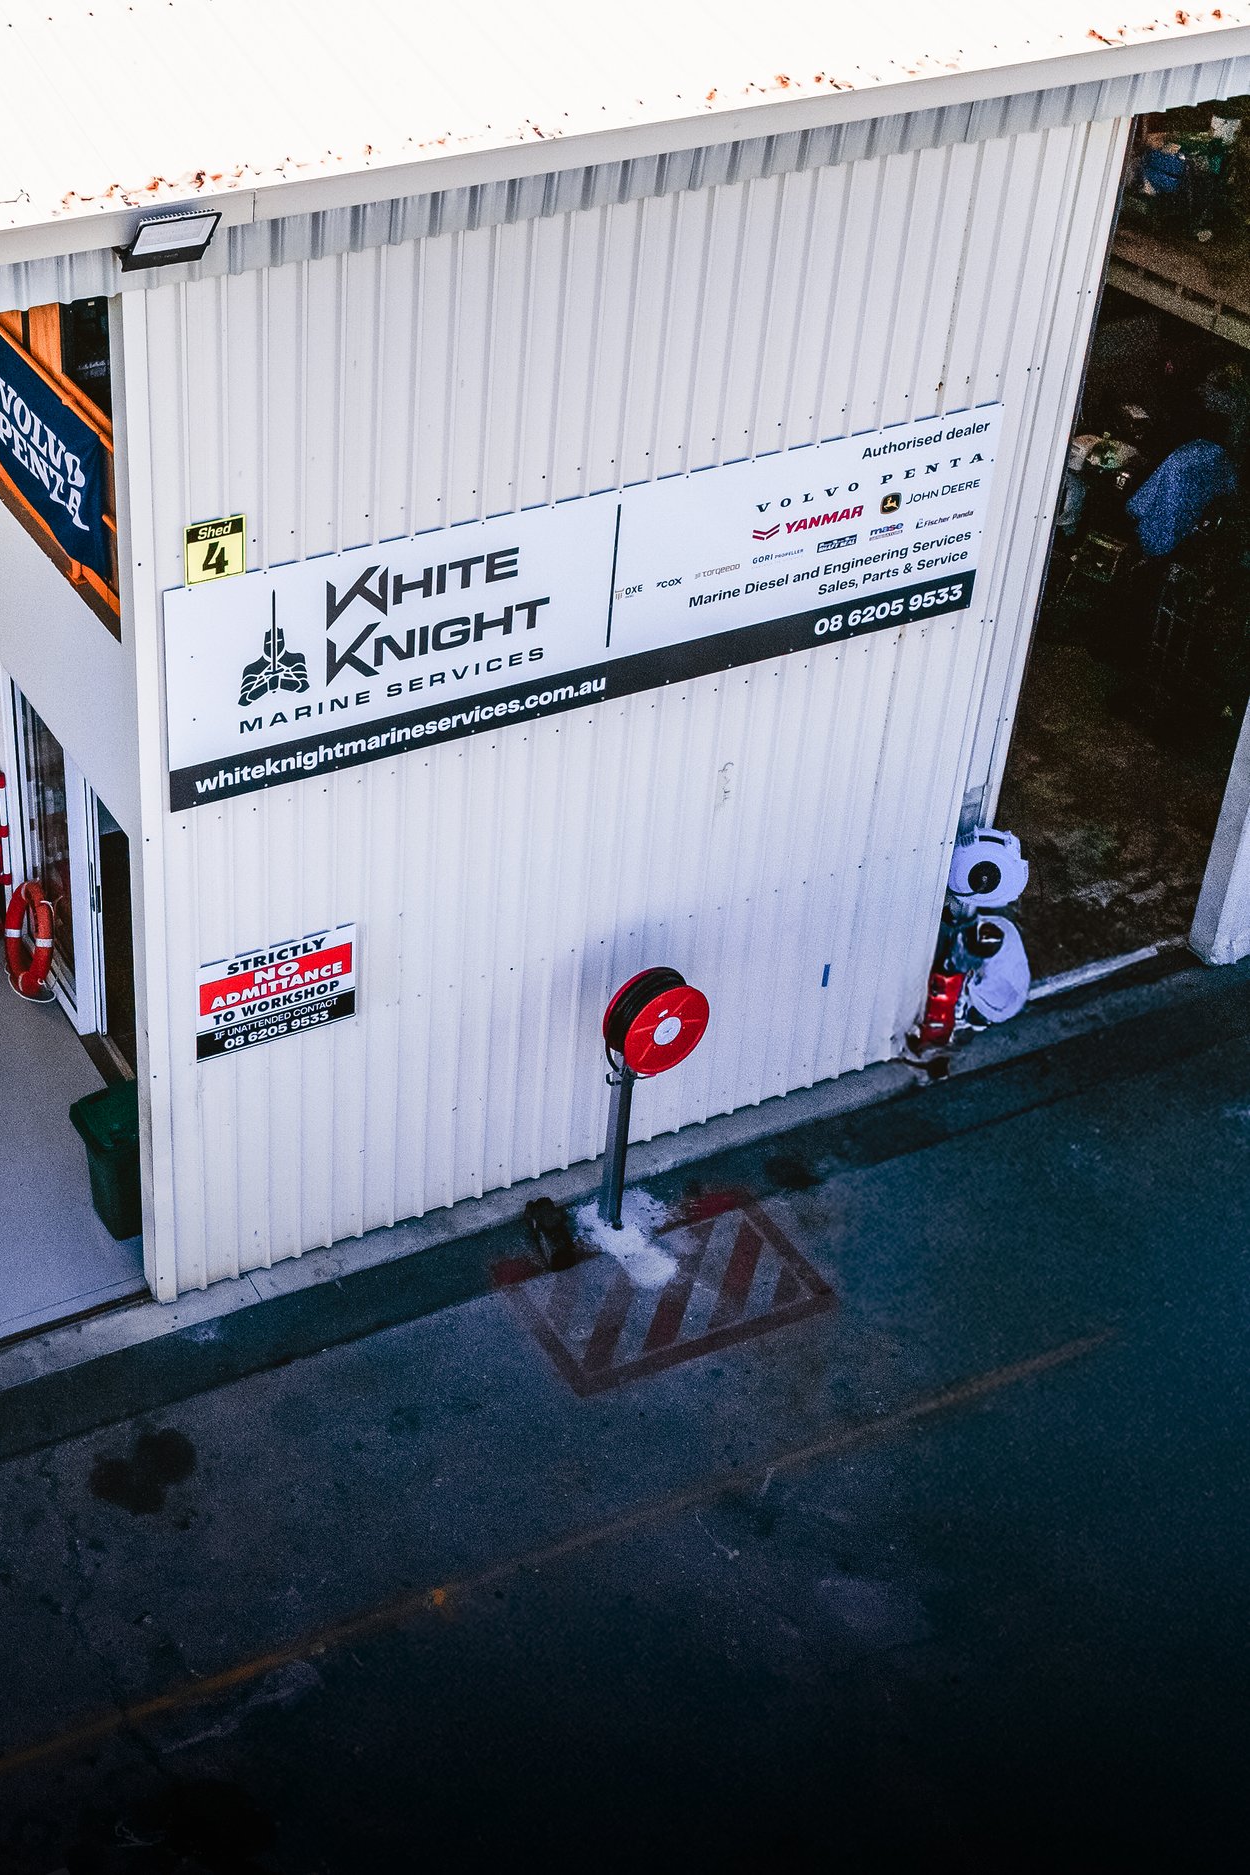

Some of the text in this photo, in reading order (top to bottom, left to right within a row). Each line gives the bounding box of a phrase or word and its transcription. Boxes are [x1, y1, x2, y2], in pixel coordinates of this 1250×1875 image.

[861, 420, 991, 460] Authorised dealer
[756, 452, 985, 514] VOLVO PENTA
[905, 478, 981, 505] JOHN DEERE
[197, 521, 232, 541] Shed
[785, 504, 864, 535] YANMAR
[870, 522, 904, 537] mase
[923, 510, 975, 528] Fischer Panda
[202, 541, 230, 576] 4
[688, 584, 740, 609] Marine
[744, 573, 790, 596] Diesel
[792, 568, 820, 586] and
[823, 546, 909, 577] Engineering
[912, 531, 972, 553] Services
[752, 553, 774, 565] GORI
[818, 550, 969, 598] Sales, Parts & Service
[326, 546, 520, 631] WHITE
[625, 584, 643, 595] OXE
[814, 582, 964, 637] 08 6205 9533
[326, 596, 551, 688] KNIGHT
[239, 646, 545, 735] MARINE SERVICES
[195, 675, 607, 795] whiteknightmarineservices.com.au
[227, 936, 327, 976] STRICTLY
[254, 961, 300, 985] NO
[210, 961, 343, 1011] ADMITTANCE
[213, 979, 340, 1026] TO WORKSHOP
[214, 997, 339, 1041] IF UNATTENDED CONTACT
[224, 1010, 330, 1049] 08 6205 9533
